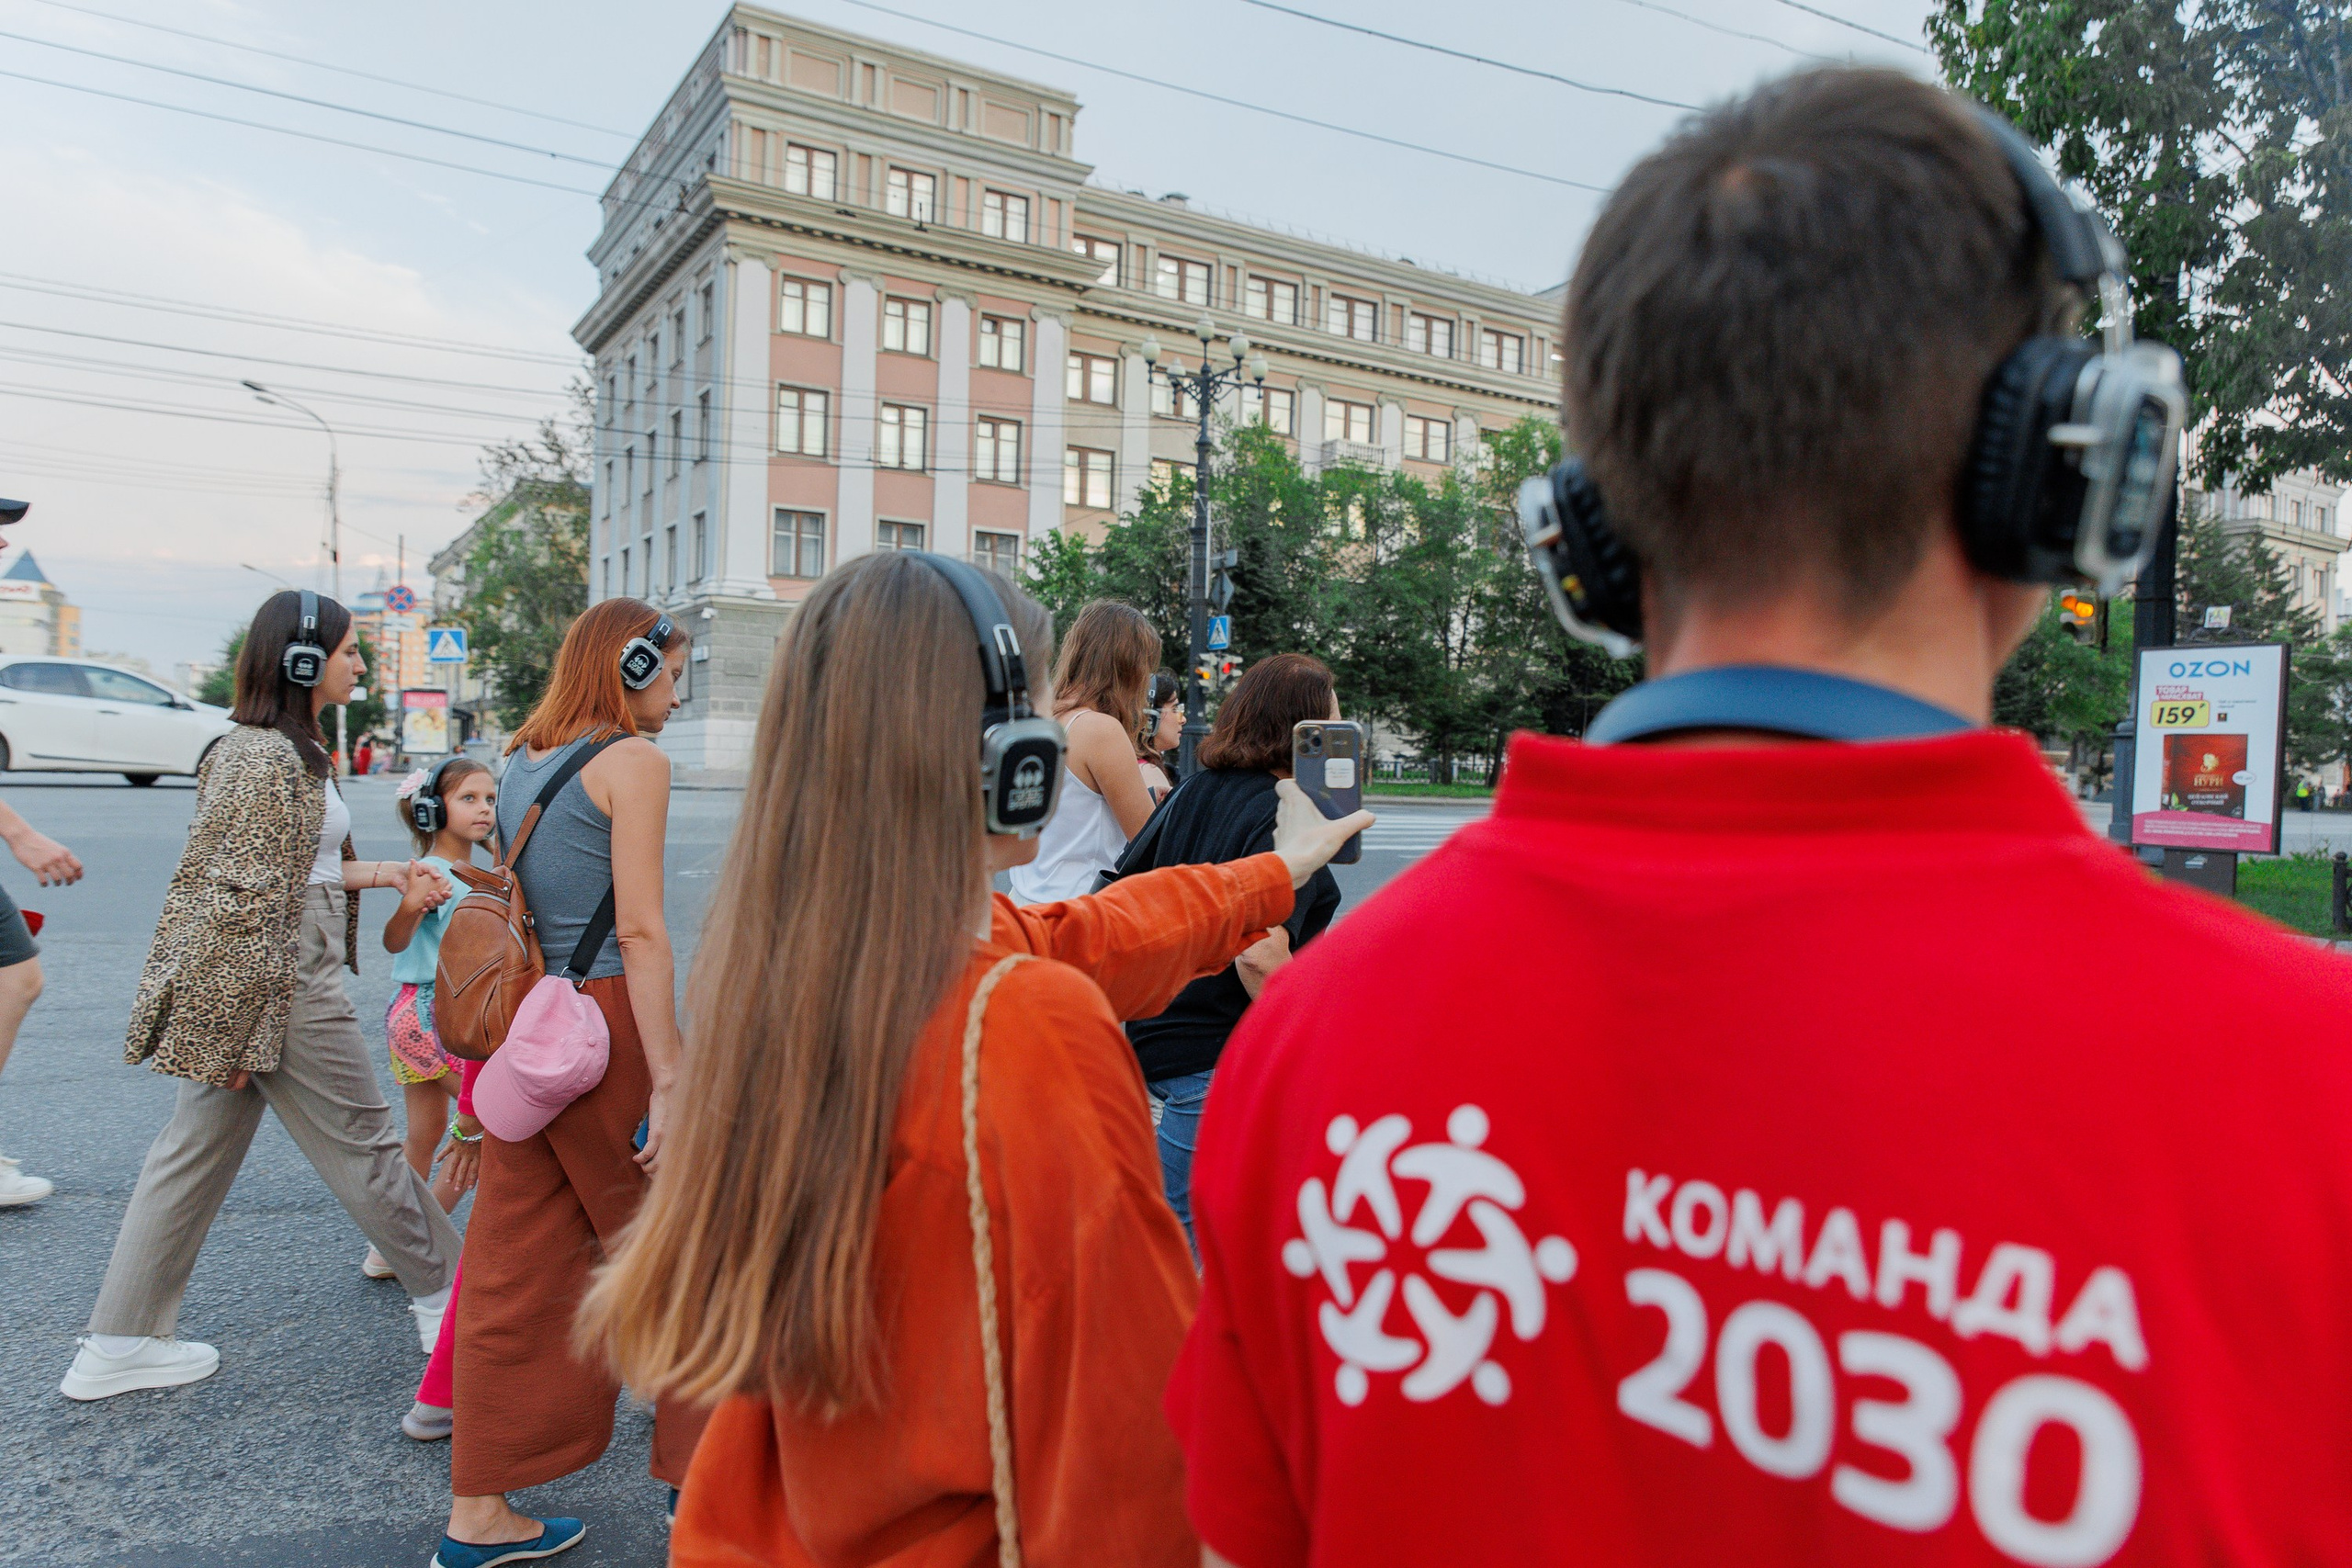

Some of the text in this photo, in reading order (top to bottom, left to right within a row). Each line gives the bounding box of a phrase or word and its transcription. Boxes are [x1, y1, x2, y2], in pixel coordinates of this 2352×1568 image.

[2169, 660, 2250, 679] OZON
[1623, 1167, 2150, 1374] КОМАНДА
[1616, 1267, 2143, 1568] 2030
